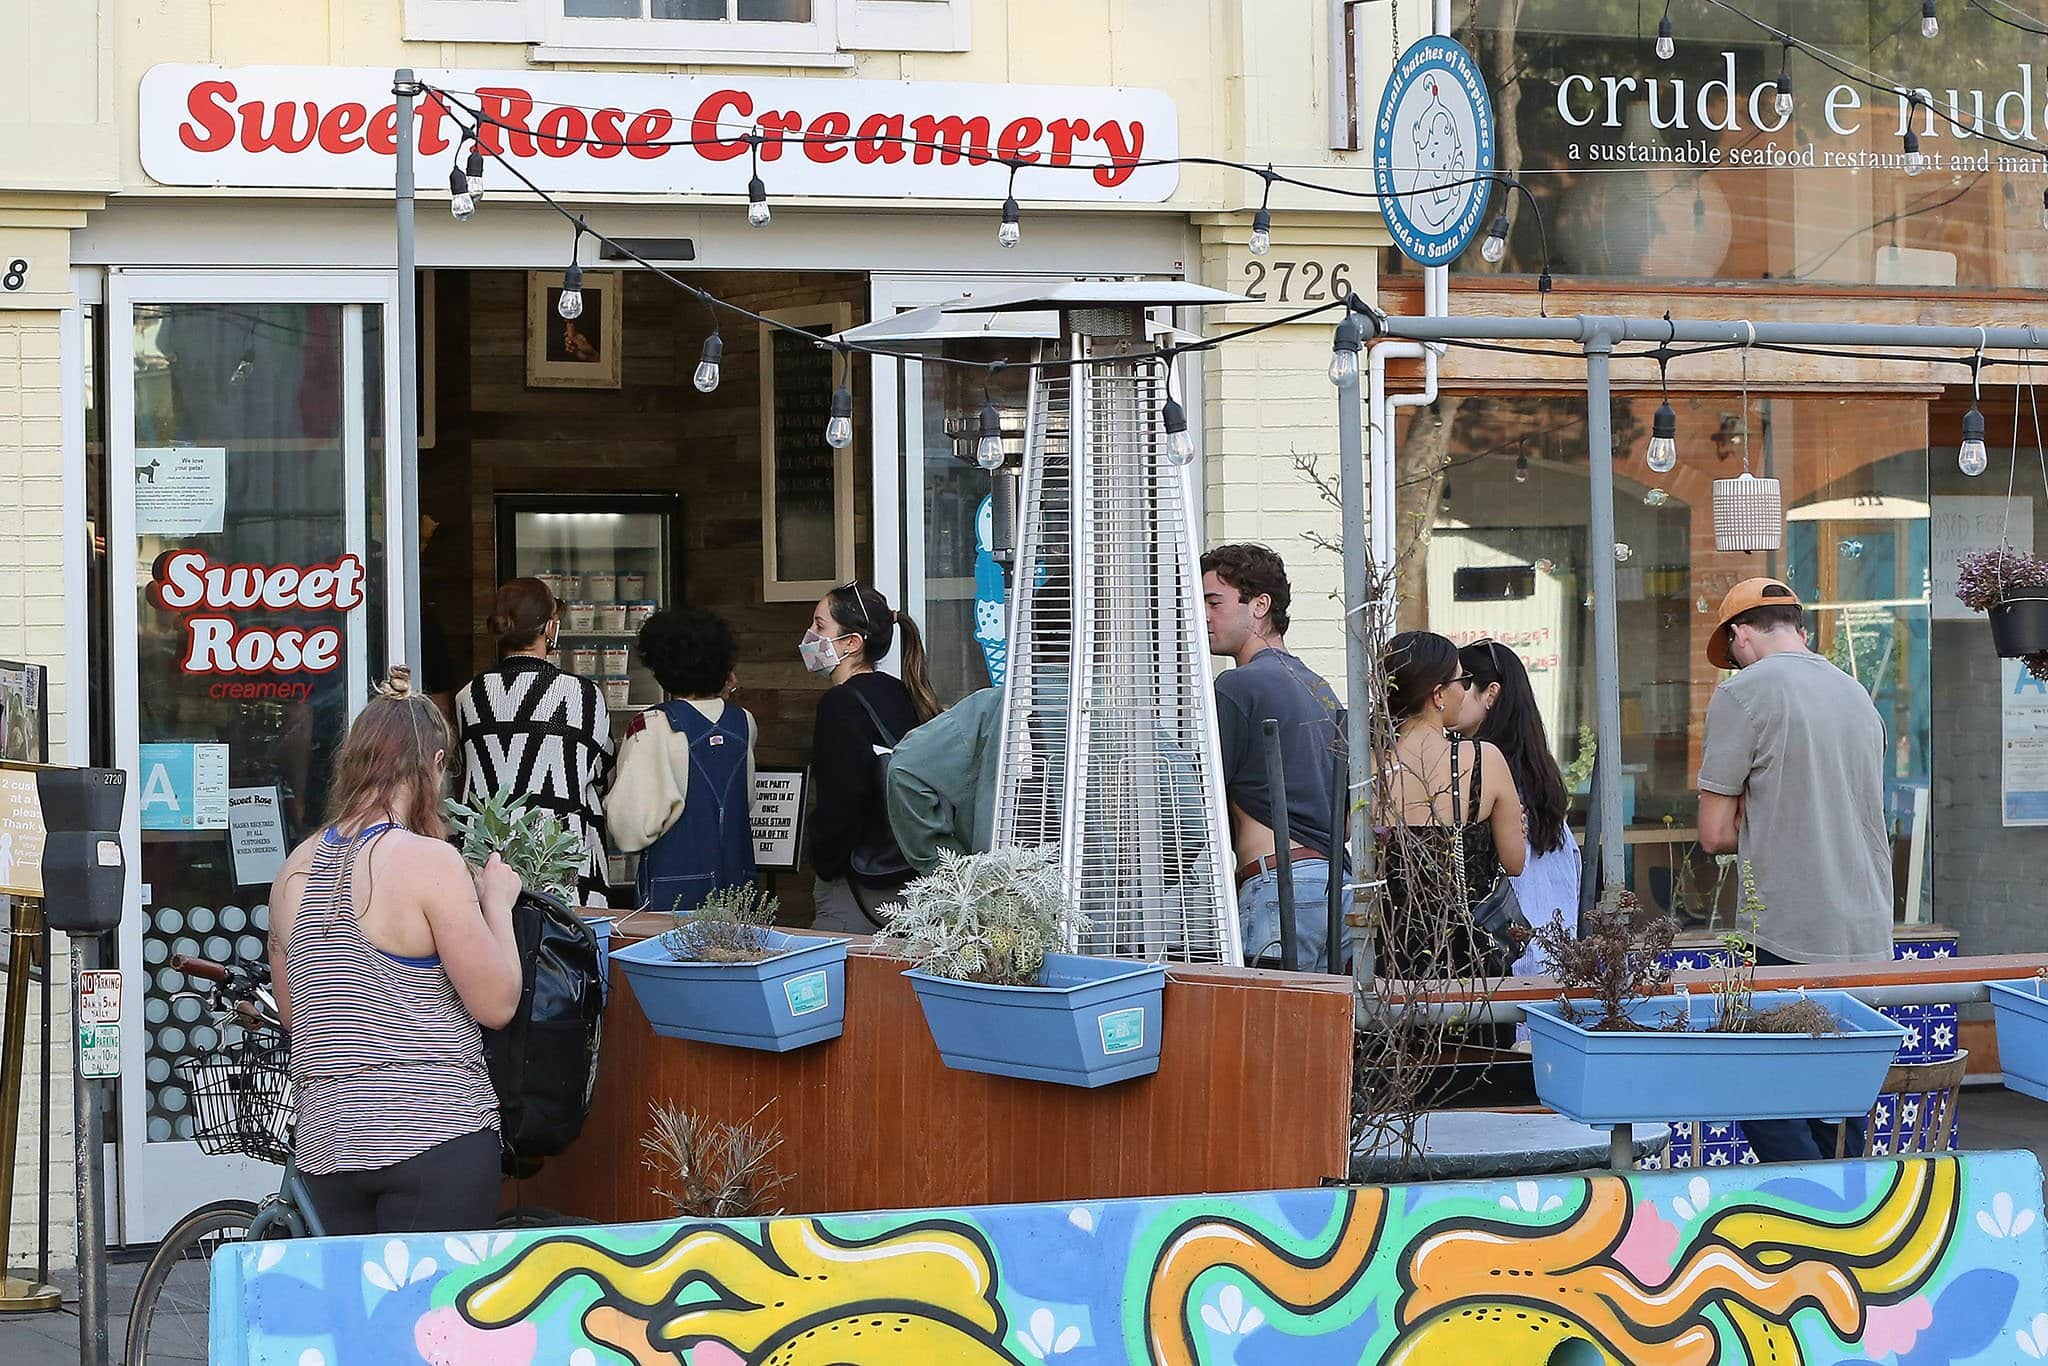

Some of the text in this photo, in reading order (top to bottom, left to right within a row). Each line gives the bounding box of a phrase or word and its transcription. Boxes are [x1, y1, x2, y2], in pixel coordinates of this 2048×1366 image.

[1381, 46, 1489, 149] Small batches of happiness
[1556, 51, 2048, 141] crudo e nud
[178, 80, 1144, 188] Sweet Rose Creamery
[1568, 142, 1581, 161] a
[1589, 138, 1721, 164] sustainable
[1728, 142, 1815, 167] seafood
[1823, 149, 1943, 171] restaurnt
[1950, 148, 1990, 172] and
[1378, 156, 1487, 258] Handmade in Santa Monica
[3, 259, 28, 291] 8
[1245, 261, 1352, 302] 2726
[161, 553, 362, 608] Sweet
[185, 618, 339, 671] Rose
[210, 682, 314, 704] creamery
[2, 779, 9, 789] 2
[104, 774, 122, 785] 2720
[756, 780, 790, 789] ONE PARTY
[140, 763, 180, 811] A
[228, 794, 272, 807] Sweet Rose
[779, 793, 785, 801] IN
[786, 792, 795, 801] AT
[761, 805, 779, 813] ONCE
[3, 818, 36, 831] Thank
[770, 817, 791, 828] STAND
[768, 829, 776, 839] OF
[777, 829, 789, 839] THE
[240, 838, 271, 846] CUSTOMERS
[760, 841, 774, 852] EXIT
[81, 975, 120, 992] NO PARKING
[91, 1009, 110, 1018] DAILY
[96, 1036, 119, 1048] PARKING
